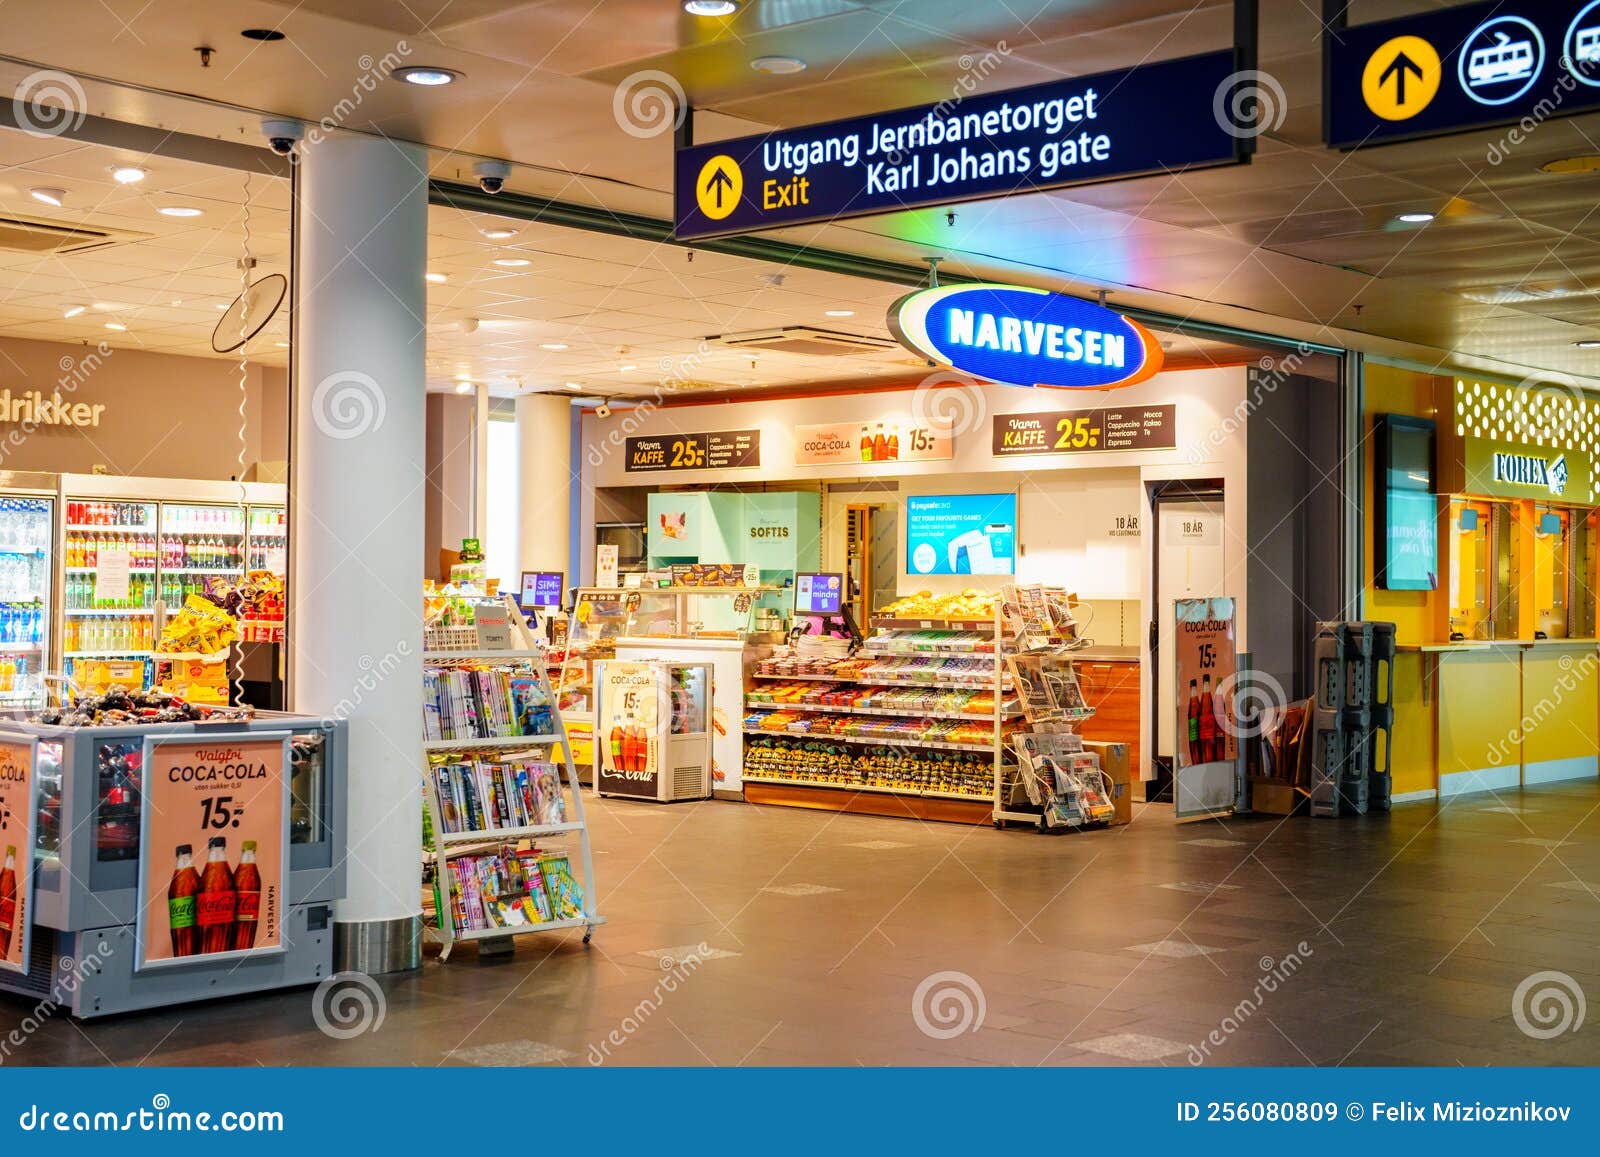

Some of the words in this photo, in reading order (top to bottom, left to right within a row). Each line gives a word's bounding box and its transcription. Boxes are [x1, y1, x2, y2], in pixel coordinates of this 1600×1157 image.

[763, 131, 859, 174] Utgang
[866, 88, 1098, 156] Jernbanetorget
[866, 155, 920, 195] Karl
[928, 141, 1031, 188] Johans
[1040, 130, 1111, 177] gate
[763, 177, 809, 210] Exit
[949, 307, 1125, 368] NARVESEN
[0, 388, 106, 427] drikker
[1009, 418, 1042, 430] Varm
[1107, 413, 1123, 421] Latte
[1107, 421, 1141, 429] Cappuccino
[1143, 419, 1162, 427] Kakao
[1003, 430, 1046, 447] KAFFE
[1107, 429, 1138, 437] Americano
[1143, 428, 1151, 437] Te
[804, 440, 851, 451] COCA-COLA
[1107, 438, 1132, 447] Espresso
[633, 451, 664, 465] KAFFE
[1493, 452, 1550, 486] FOREX
[1115, 517, 1125, 529] 18
[1127, 514, 1138, 529] ÅR
[1183, 522, 1192, 533] 18
[1193, 519, 1203, 533] ÅR
[750, 526, 789, 538] SOFTIS
[812, 590, 838, 599] mindre
[1185, 619, 1227, 632] COCA-COLA
[610, 675, 650, 685] COCA-COLA
[195, 748, 243, 764] Valgfri
[168, 763, 267, 783] COCA-COLA
[210, 782, 230, 790] sukker
[267, 885, 275, 938] NARVESEN
